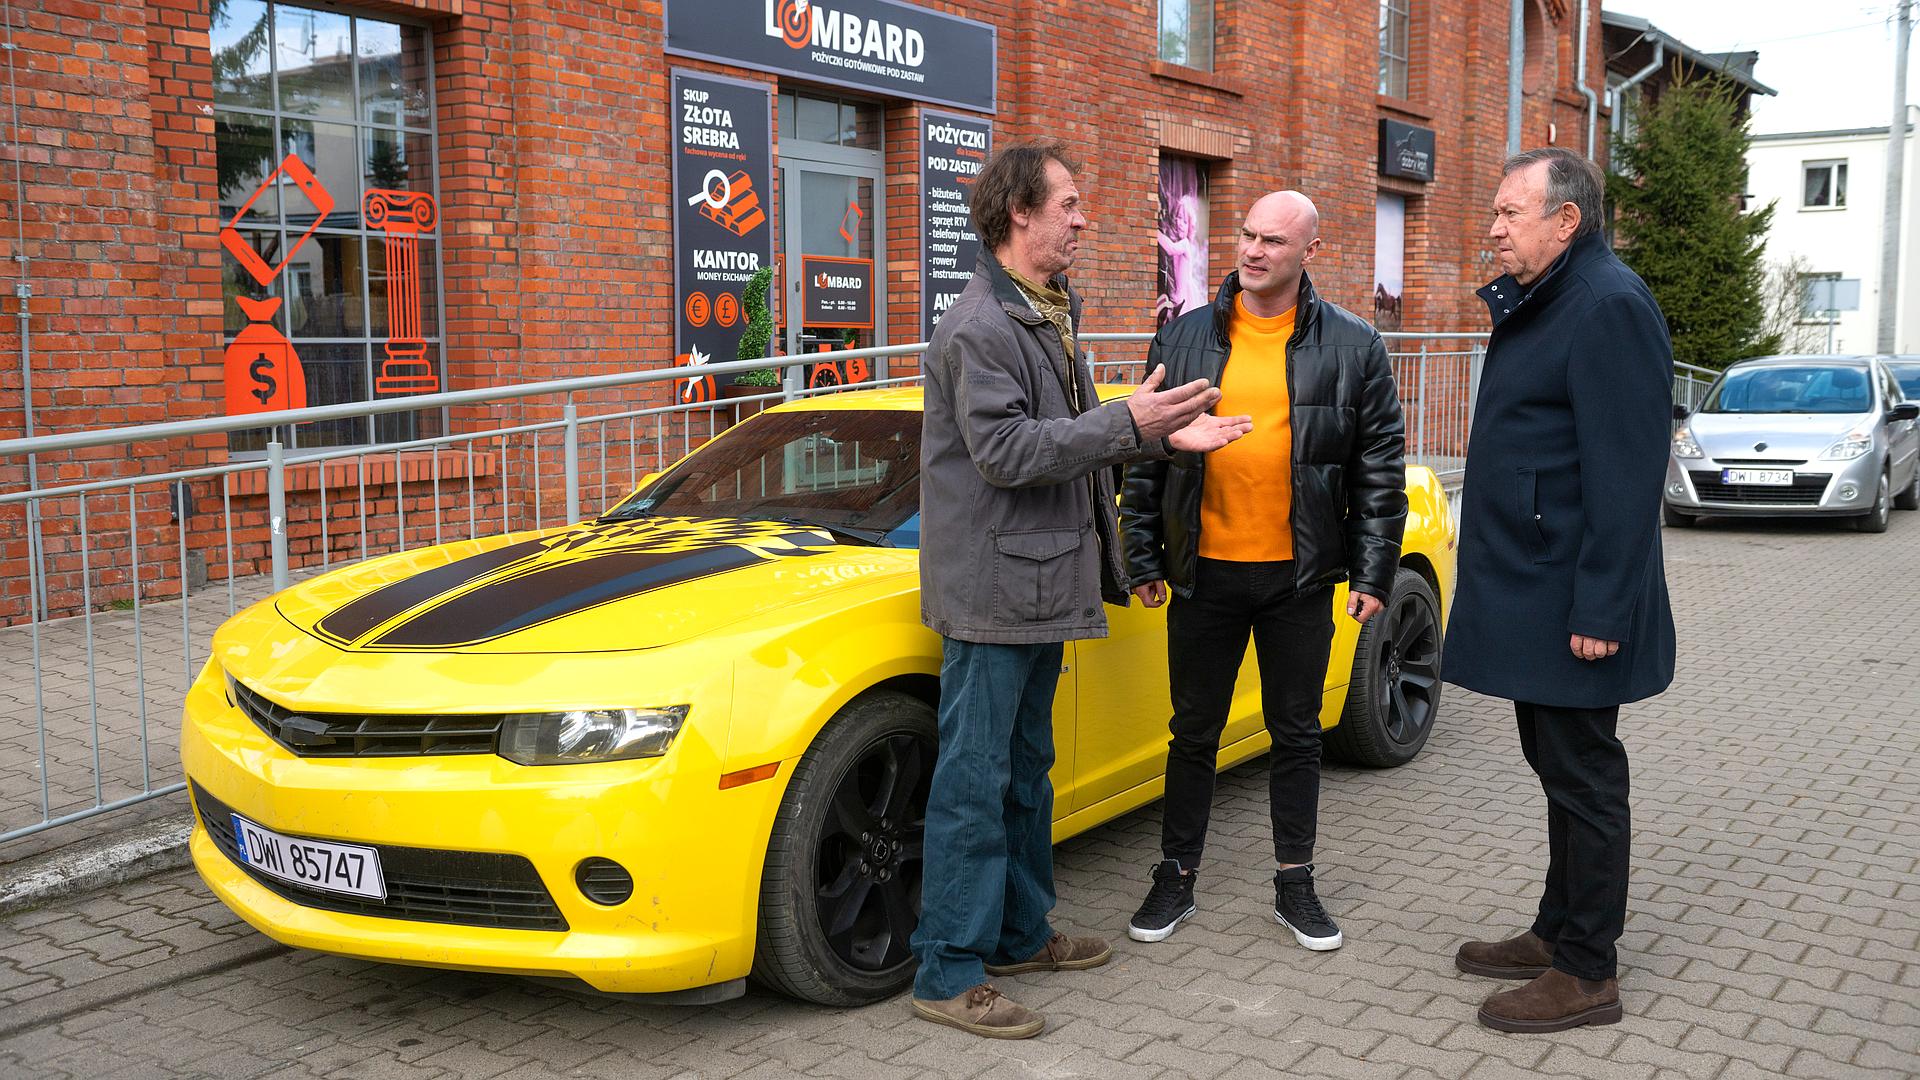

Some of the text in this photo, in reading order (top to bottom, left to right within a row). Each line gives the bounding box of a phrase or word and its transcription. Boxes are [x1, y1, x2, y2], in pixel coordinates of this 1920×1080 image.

[766, 0, 924, 67] LOMBARD
[812, 52, 924, 82] POŻYCZKI GOTÓWKOWE POD ZASTAW
[684, 88, 709, 103] SKUP
[684, 104, 733, 128] ZŁOTA
[684, 126, 740, 150] SREBRA
[928, 122, 985, 149] POŻYCZKI
[928, 156, 948, 170] POD
[932, 187, 962, 200] biżuteria
[932, 201, 970, 214] elektronika
[932, 217, 967, 228] sprzęt RTV
[932, 228, 978, 242] telefony kom.
[933, 243, 958, 255] motory
[693, 250, 760, 270] KANTOR
[933, 257, 957, 268] rowery
[697, 272, 753, 282] MONEY EXCHANG
[815, 272, 862, 289] LOMBARD
[1730, 471, 1752, 482] DWI
[1760, 472, 1789, 483] 8734
[247, 828, 364, 889] DWI 85747
